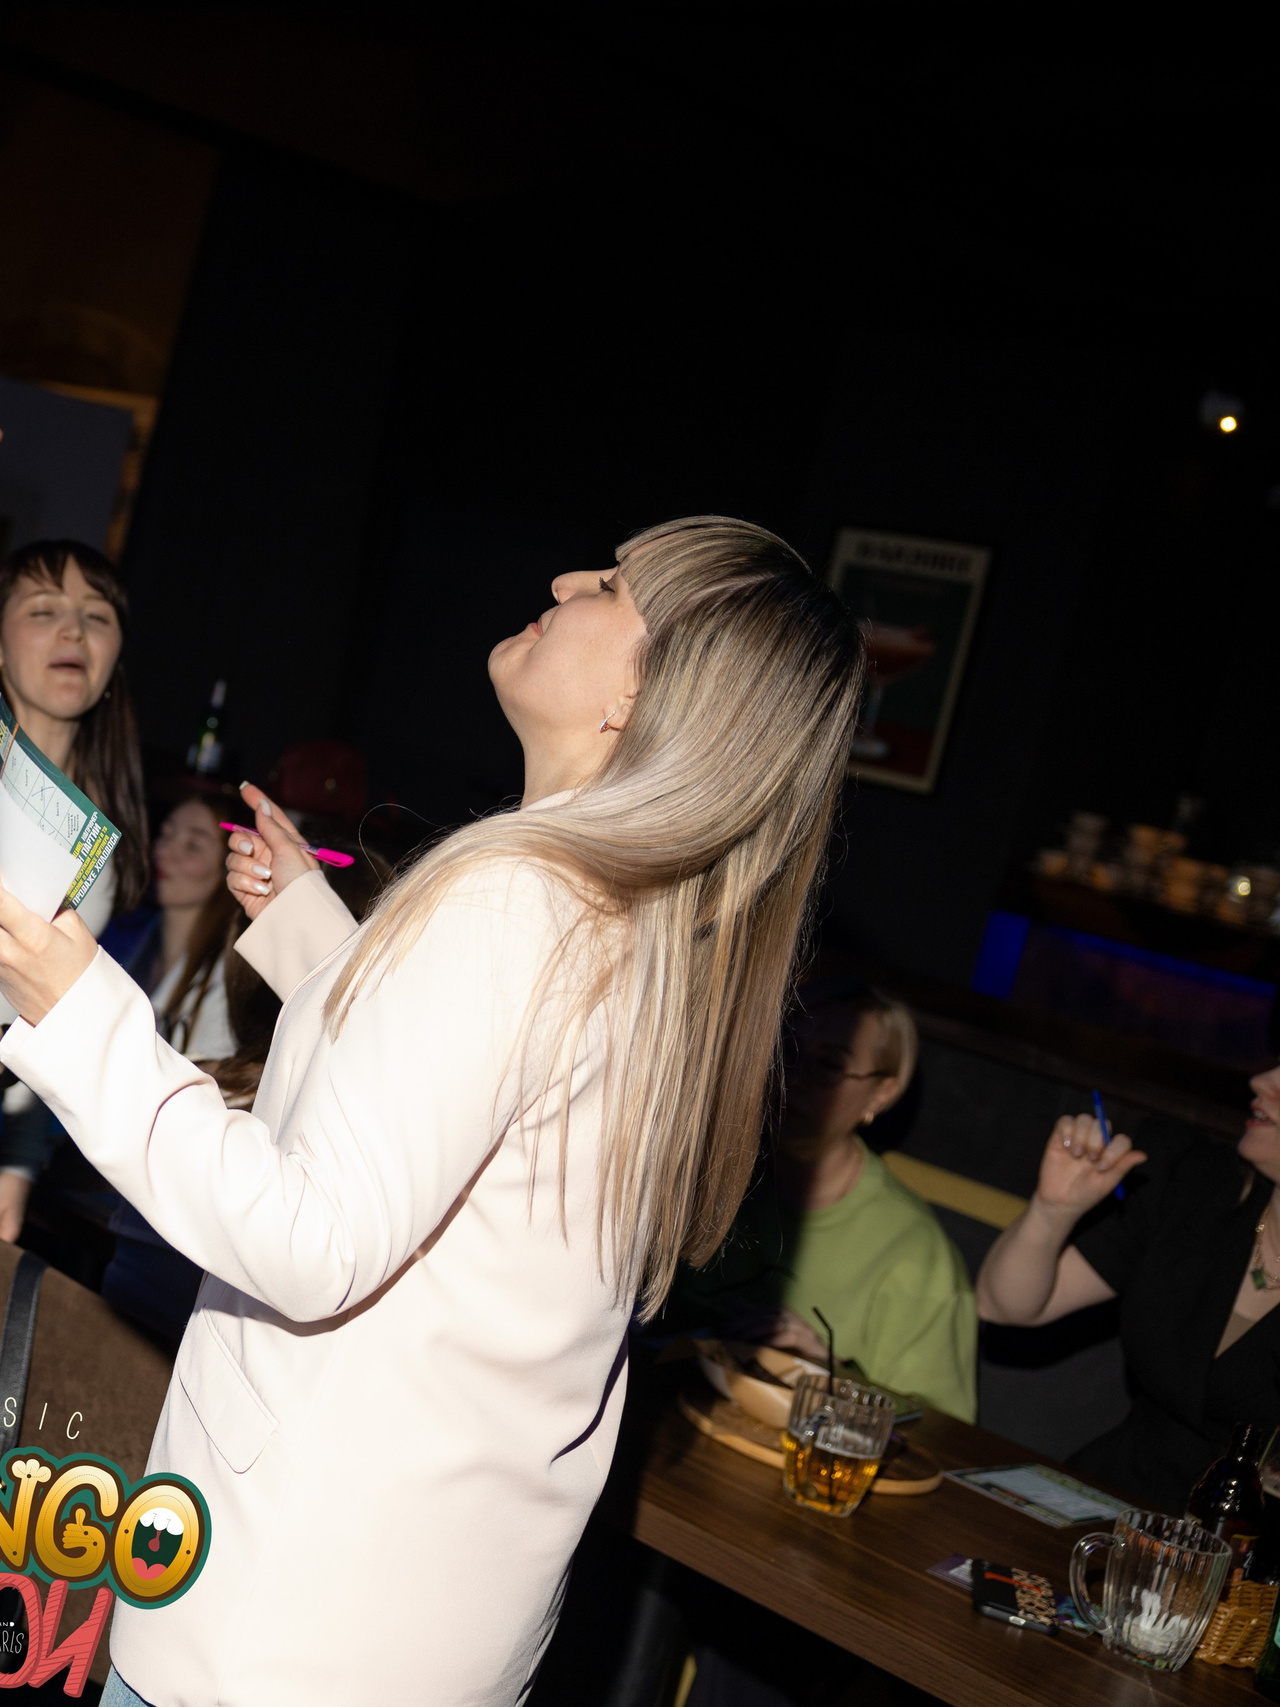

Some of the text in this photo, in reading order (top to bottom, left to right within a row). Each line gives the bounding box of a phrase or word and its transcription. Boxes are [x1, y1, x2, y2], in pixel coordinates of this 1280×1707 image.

[81, 822, 101, 858] ПАРТИИ
[72, 870, 97, 906] ПРОДАЖЕ
[94, 832, 119, 872] ХОЛОДОСА
